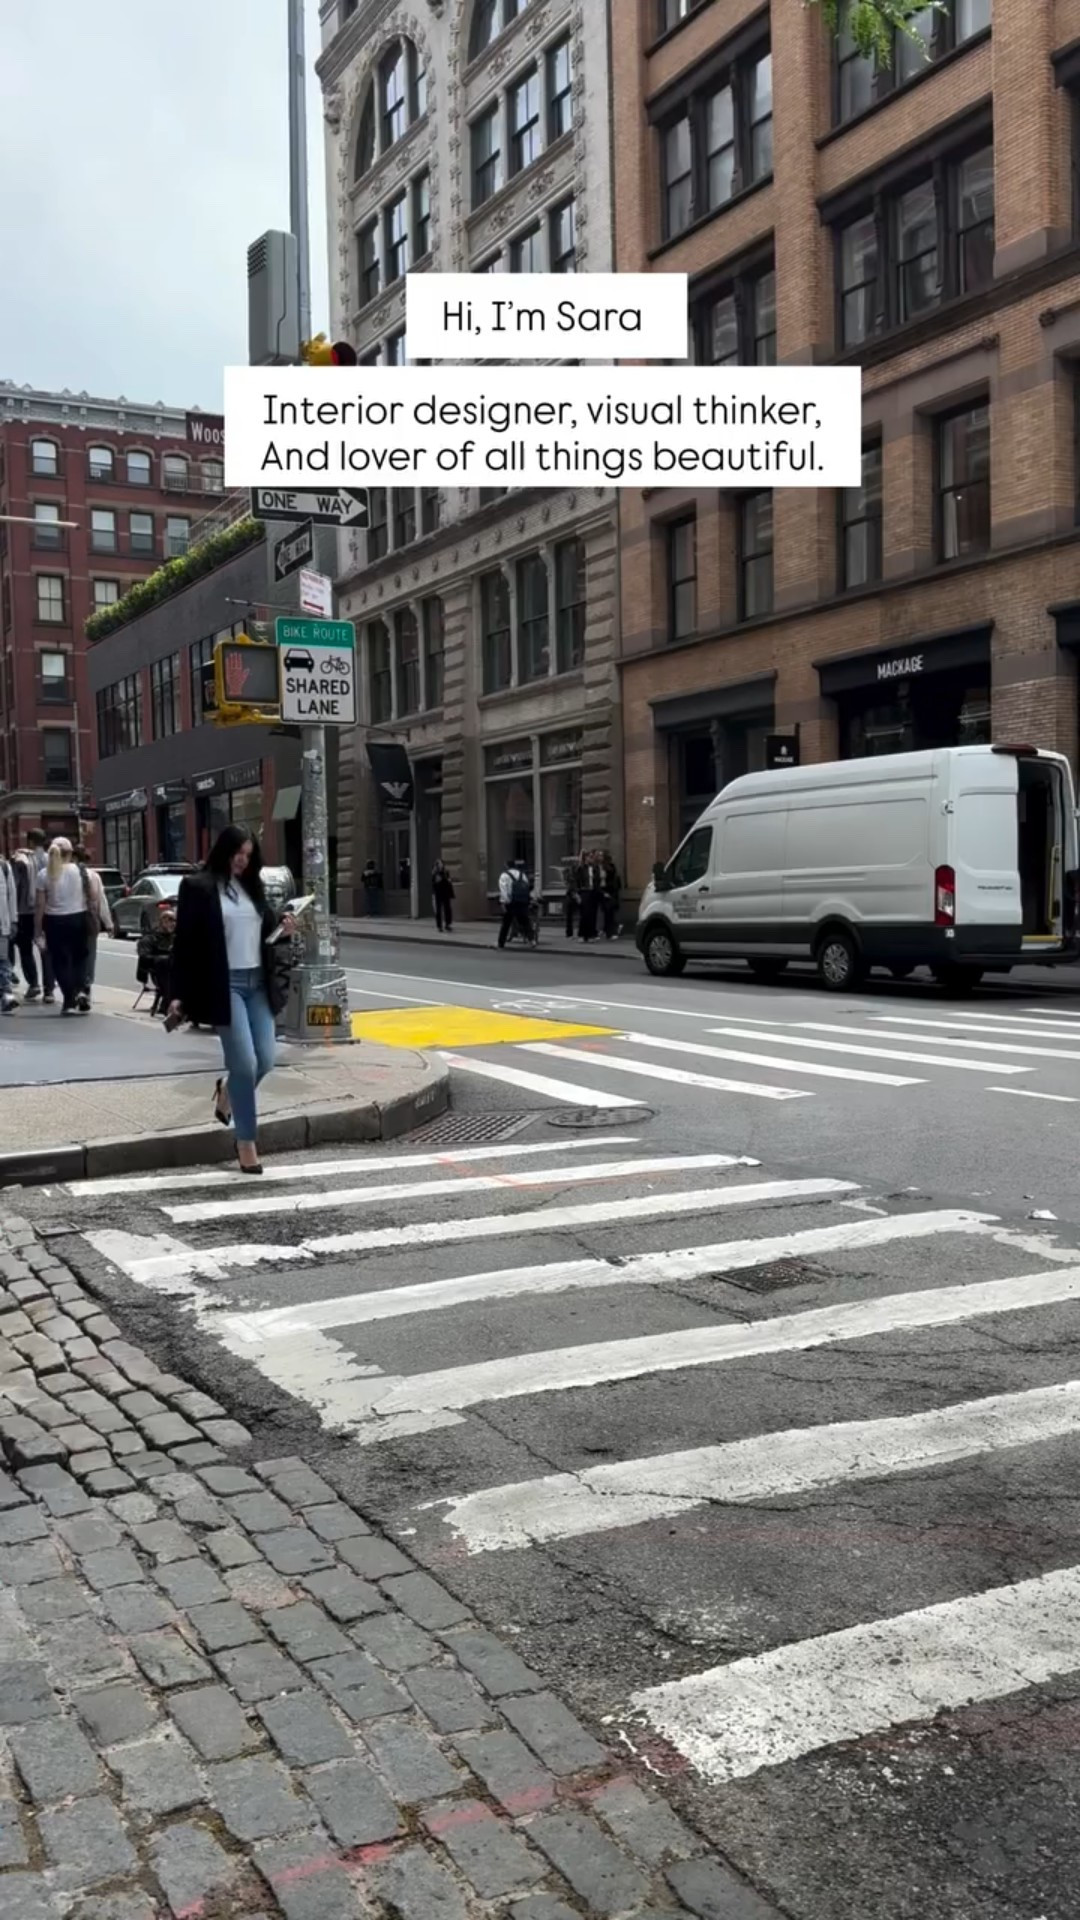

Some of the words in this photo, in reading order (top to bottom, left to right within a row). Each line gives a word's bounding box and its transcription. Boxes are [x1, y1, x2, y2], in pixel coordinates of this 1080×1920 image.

[262, 491, 297, 510] ONE
[317, 497, 353, 514] WAY
[283, 625, 307, 638] BIKE
[313, 628, 348, 640] ROUTE
[877, 654, 924, 679] MACKAGE
[286, 677, 350, 695] SHARED
[298, 699, 340, 715] LANE
